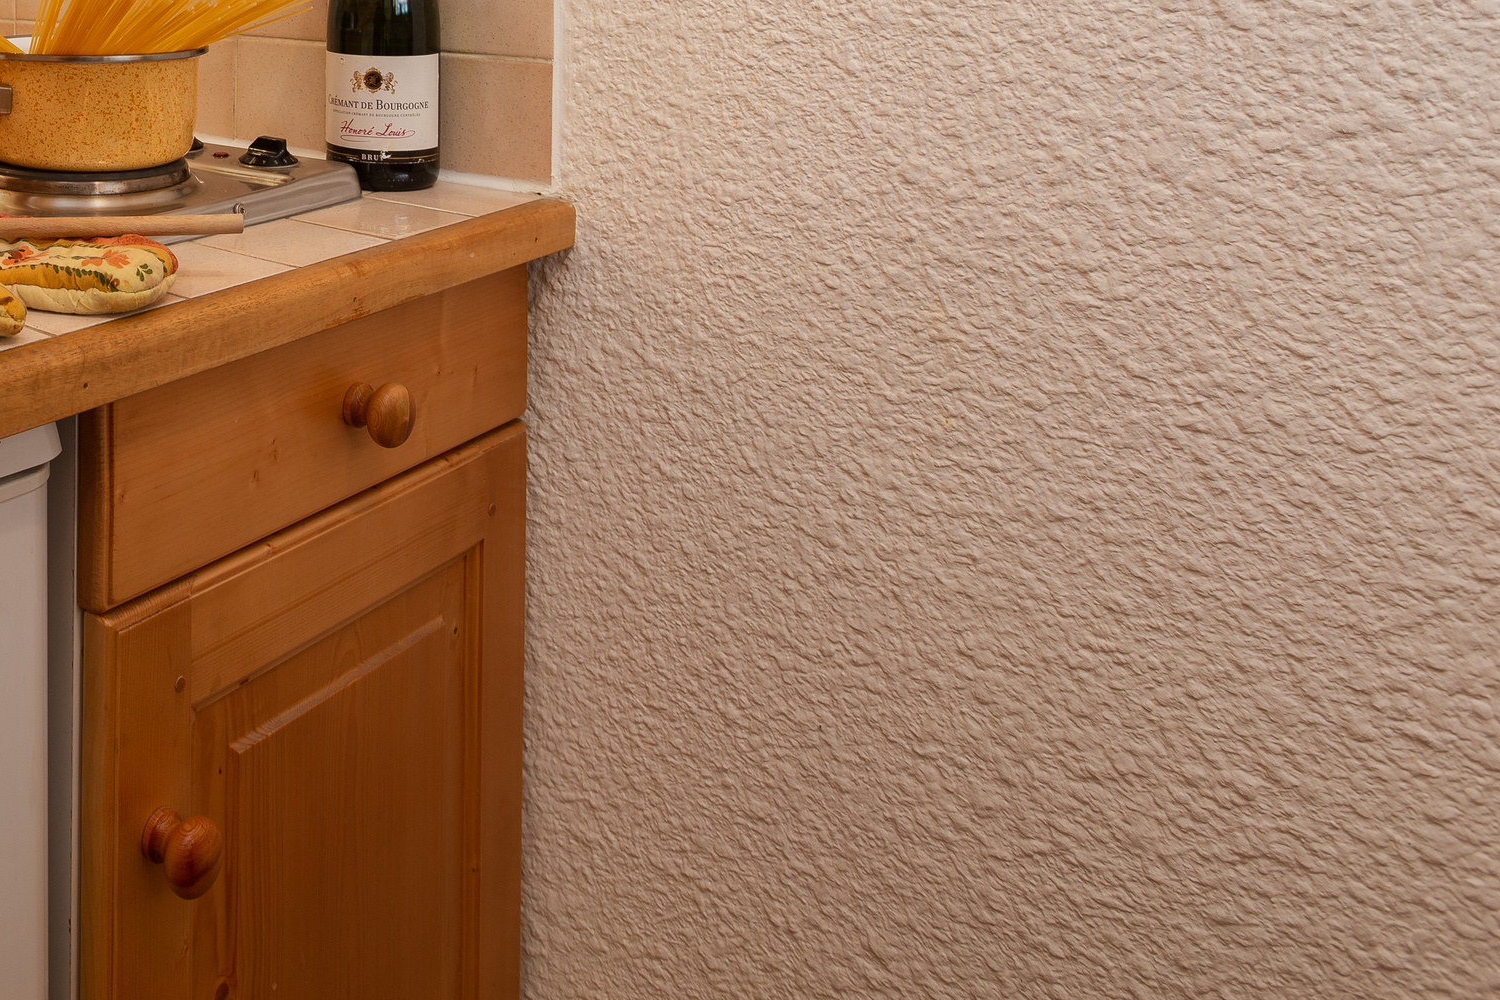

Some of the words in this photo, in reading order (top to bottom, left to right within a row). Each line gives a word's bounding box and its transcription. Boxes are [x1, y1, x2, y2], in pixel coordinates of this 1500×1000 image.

[328, 93, 360, 109] CRÉMANT
[361, 101, 374, 110] DE
[376, 99, 429, 111] BOURGOGNE
[340, 118, 375, 136] Honoré
[375, 122, 410, 137] Louis
